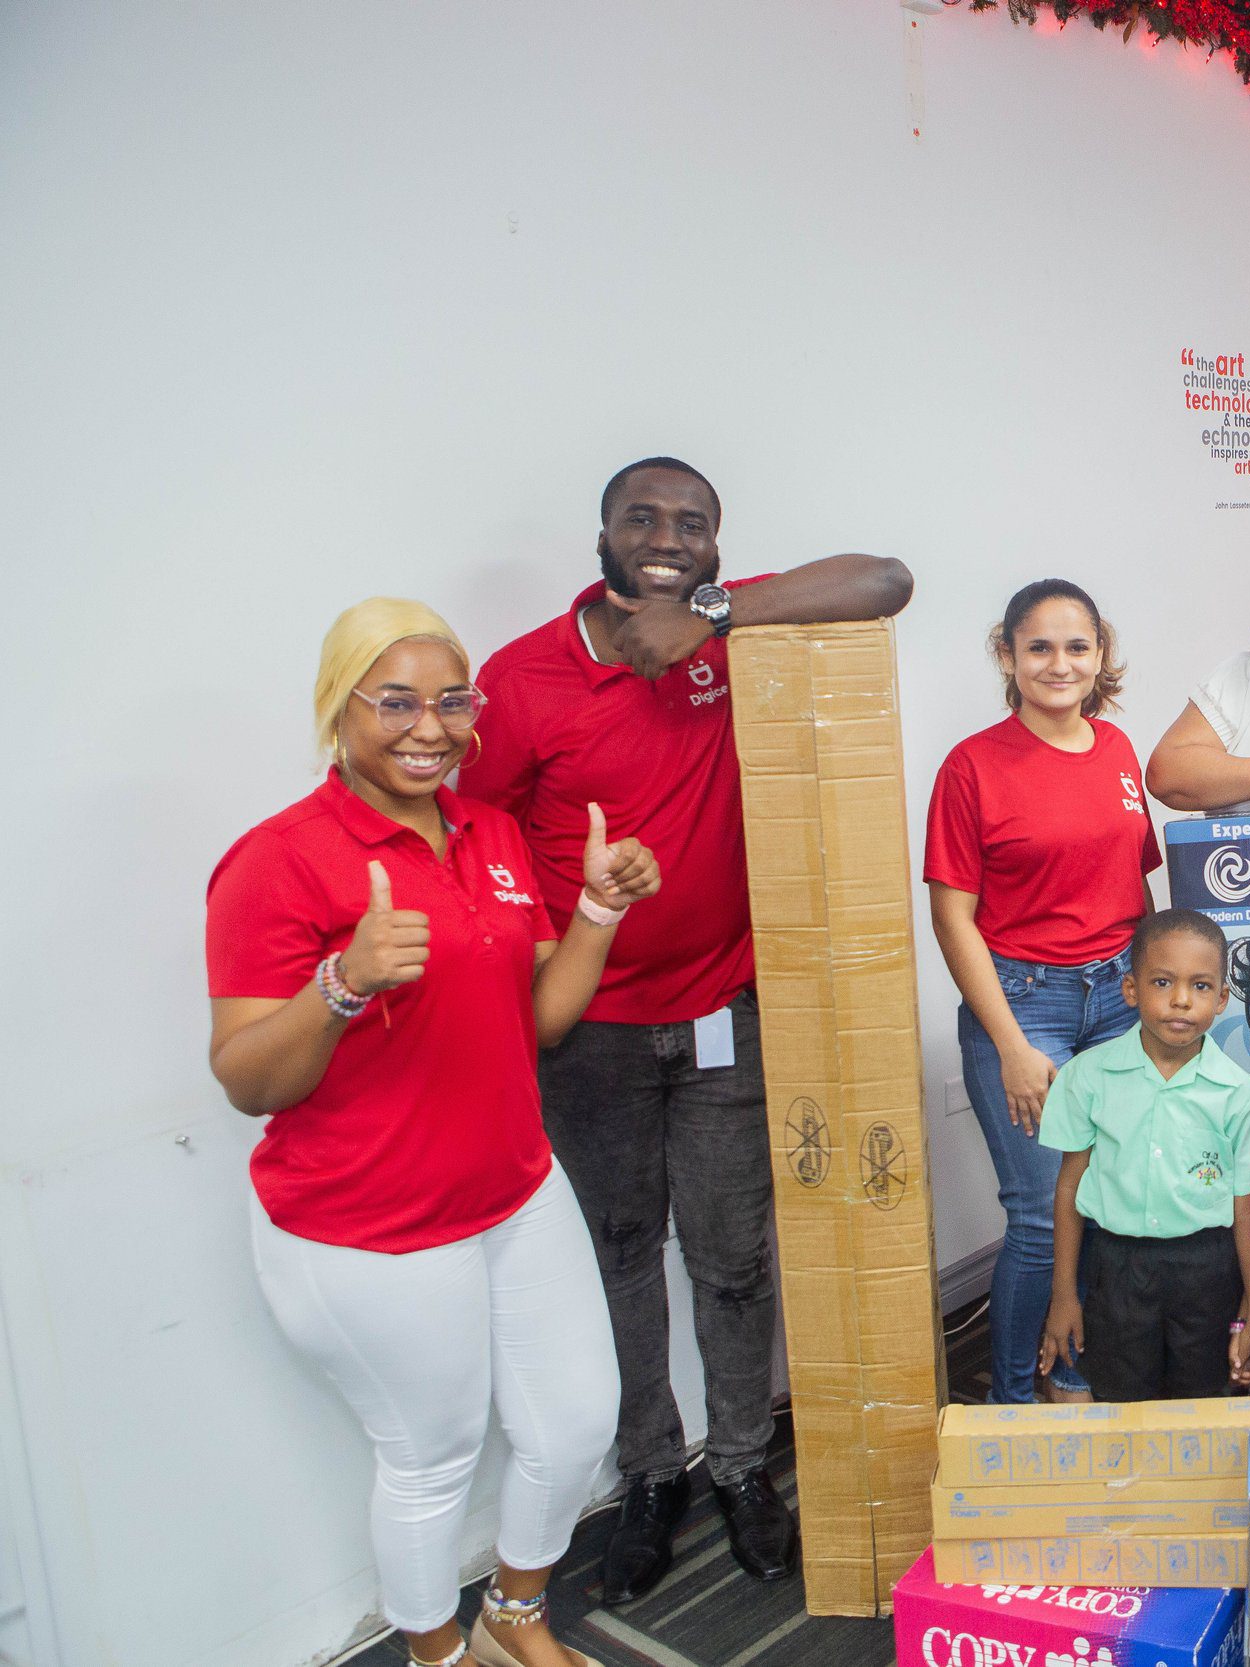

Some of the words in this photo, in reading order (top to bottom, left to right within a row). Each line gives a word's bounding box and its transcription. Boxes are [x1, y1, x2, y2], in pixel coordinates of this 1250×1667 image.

[1216, 353, 1244, 377] art
[1224, 413, 1231, 427] &
[1234, 414, 1250, 428] the
[1211, 446, 1248, 462] inspires
[689, 685, 728, 706] Digice
